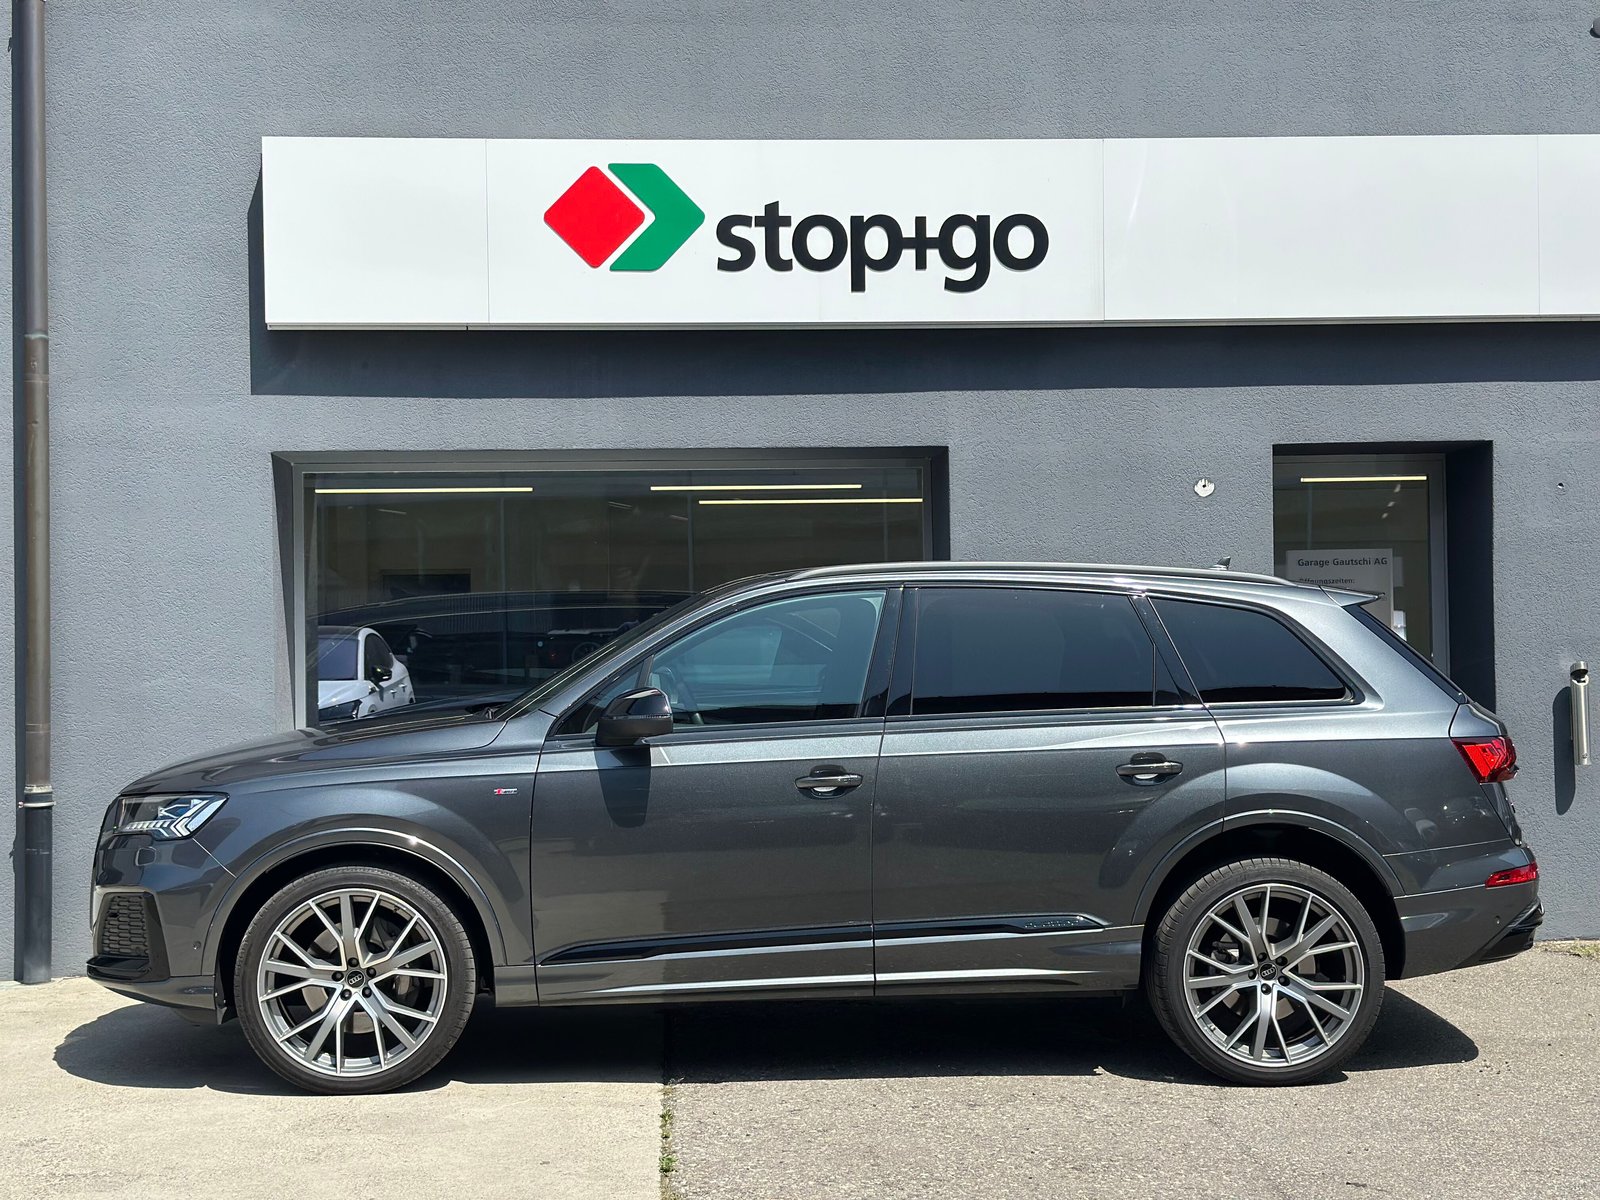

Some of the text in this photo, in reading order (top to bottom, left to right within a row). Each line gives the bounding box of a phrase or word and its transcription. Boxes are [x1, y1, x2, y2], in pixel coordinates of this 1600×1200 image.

[716, 200, 1049, 293] stop+go
[1297, 557, 1388, 568] Garage Gautschi AG
